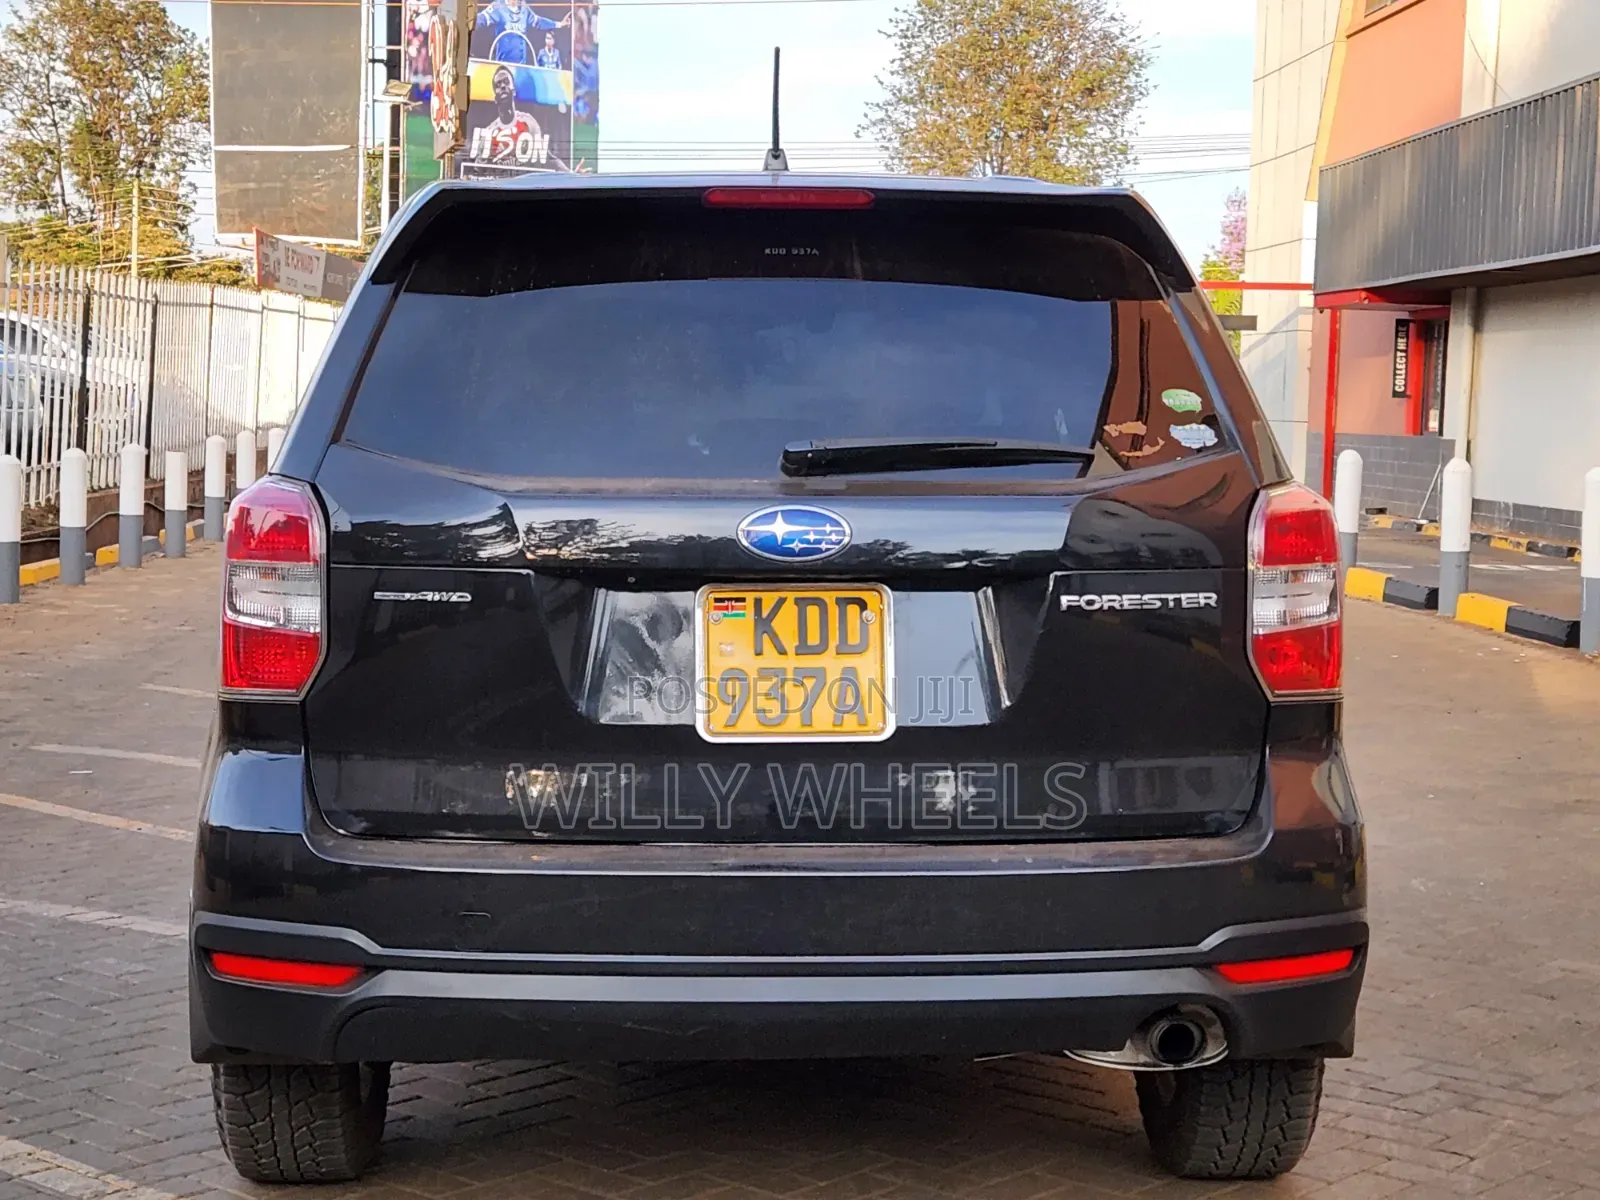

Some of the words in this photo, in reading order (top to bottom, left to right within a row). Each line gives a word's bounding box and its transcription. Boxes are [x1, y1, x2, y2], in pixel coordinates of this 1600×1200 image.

[515, 132, 549, 164] ON
[1394, 351, 1406, 392] COLLECT
[1060, 592, 1218, 611] FORESTER
[753, 596, 869, 656] KDD
[717, 667, 868, 727] 937A
